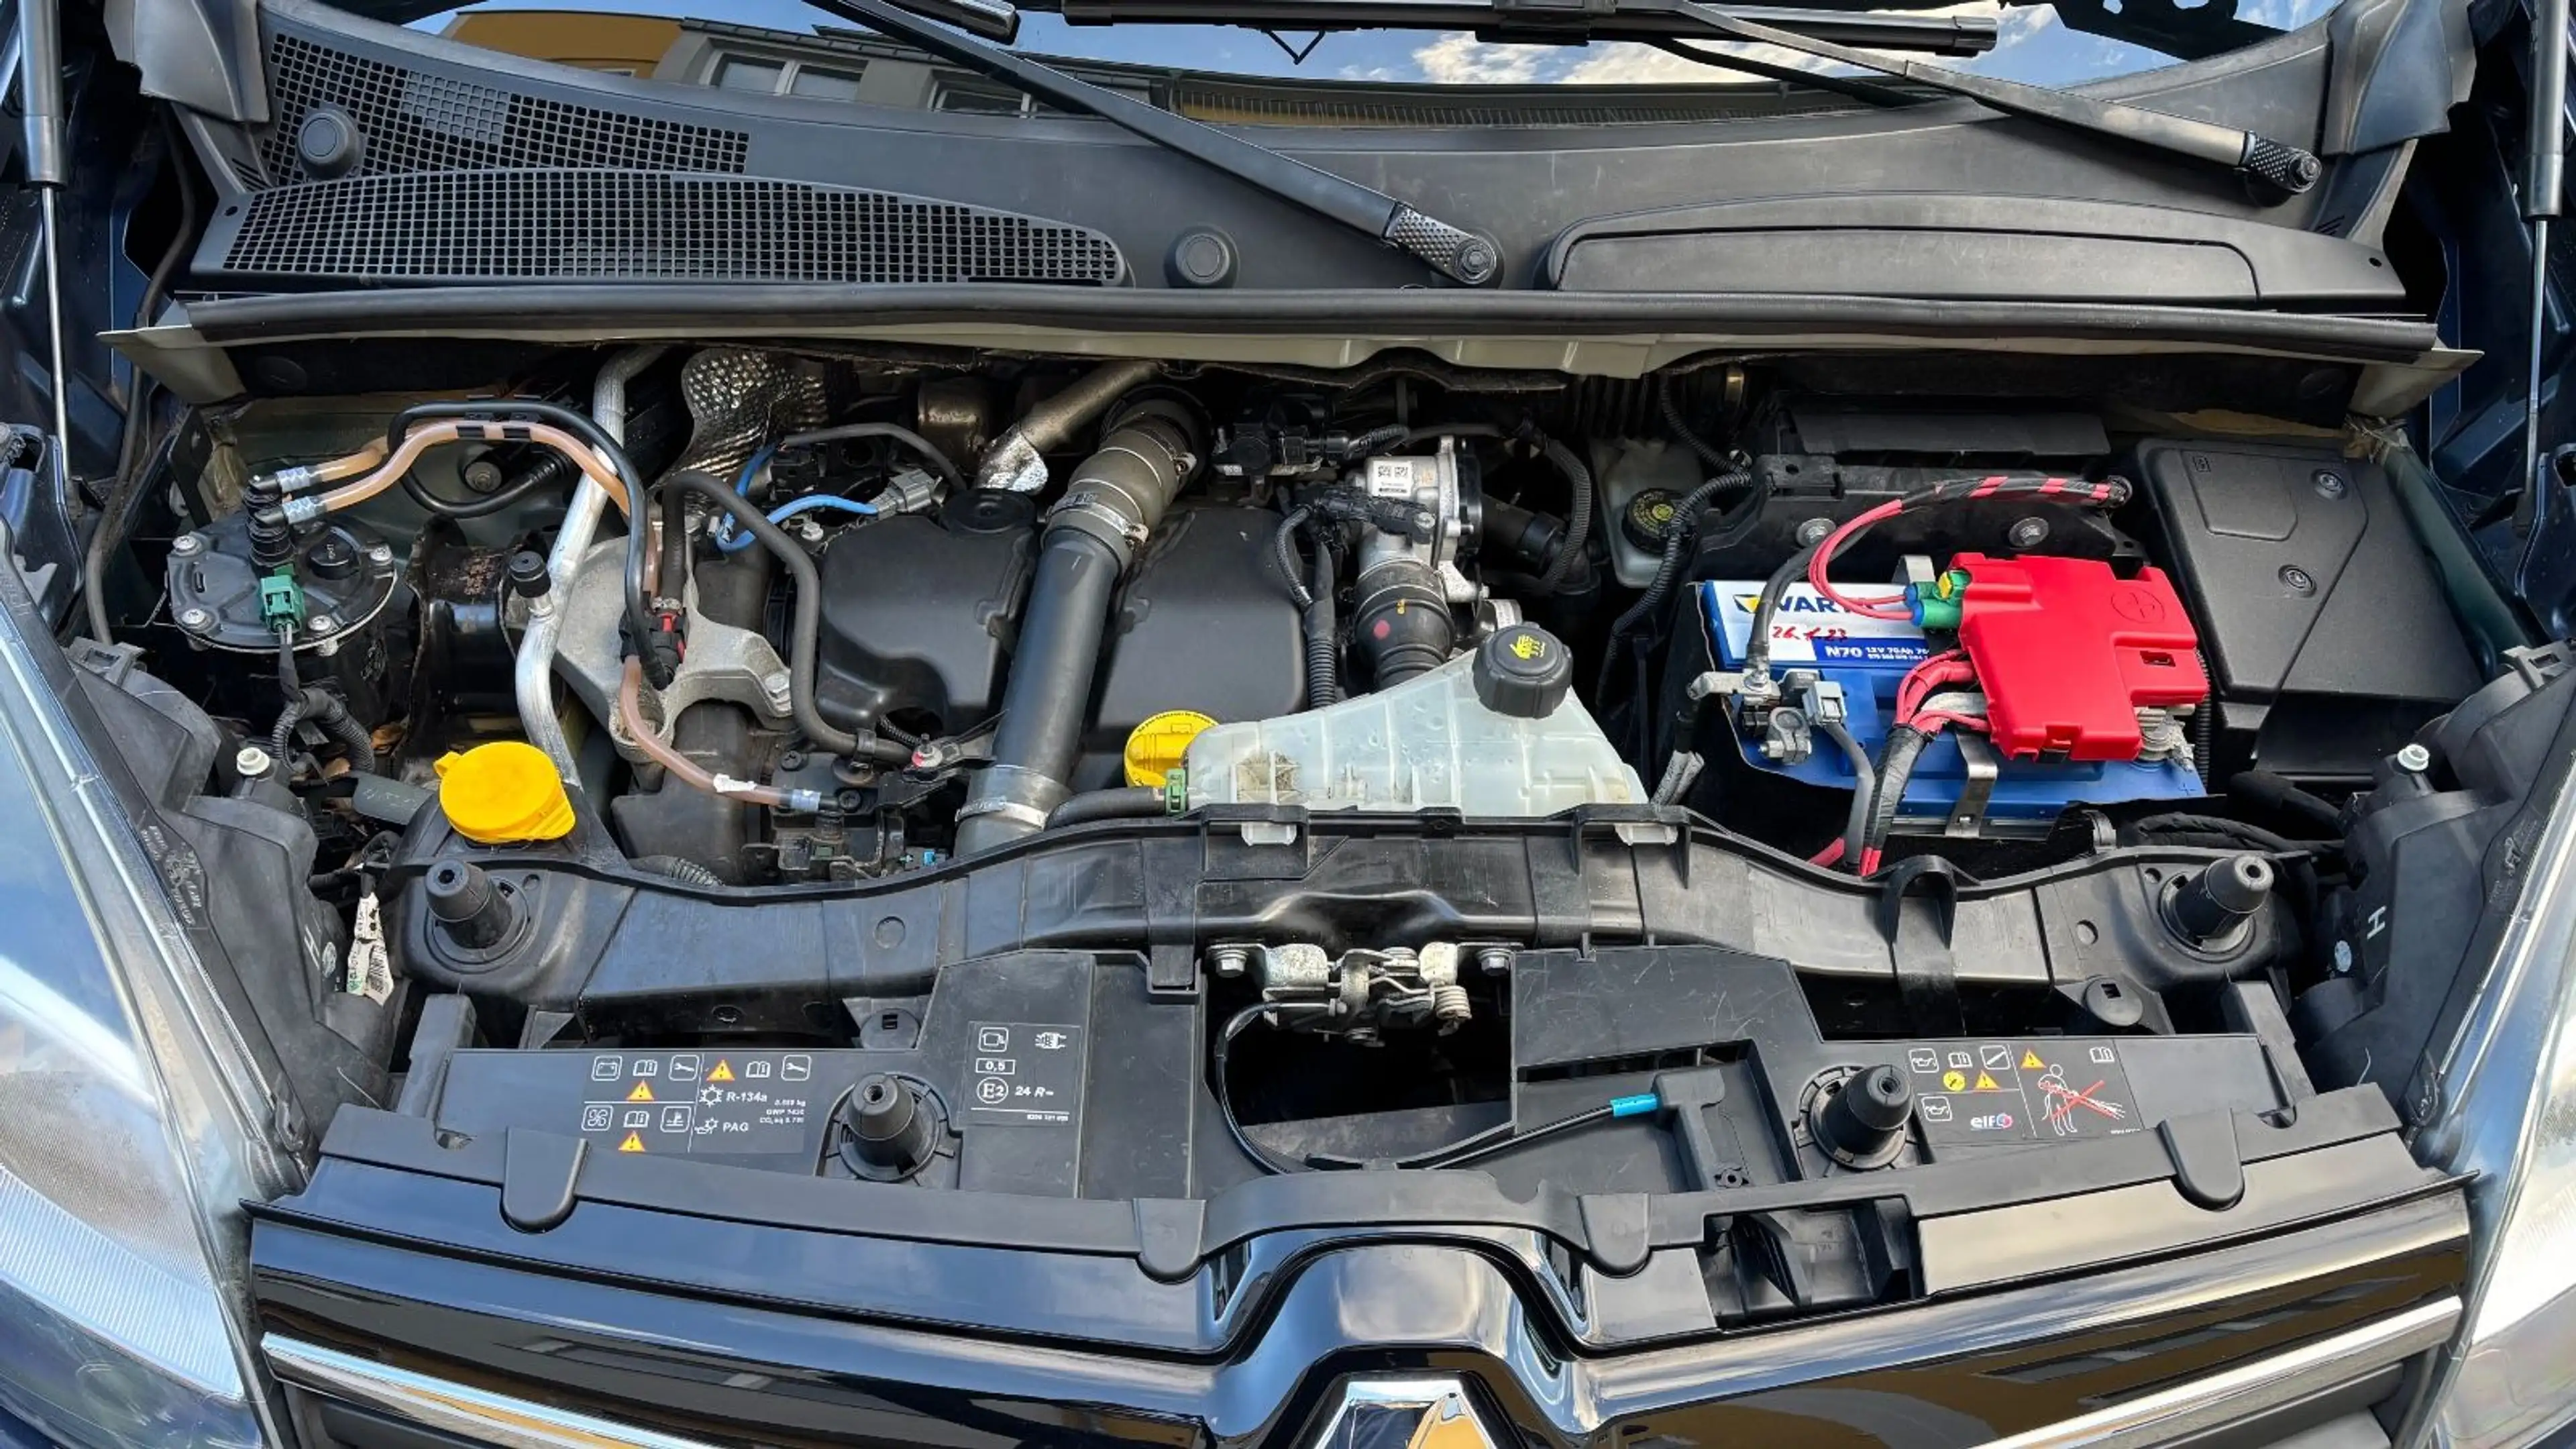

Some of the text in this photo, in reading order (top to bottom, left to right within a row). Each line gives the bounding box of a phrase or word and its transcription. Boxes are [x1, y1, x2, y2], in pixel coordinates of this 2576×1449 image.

[1824, 645, 1862, 658] N70
[985, 1061, 1006, 1073] 0,5
[726, 1091, 768, 1103] R-134a
[982, 1083, 1005, 1099] E2
[1014, 1085, 1032, 1096] 24
[722, 1122, 749, 1132] PAG
